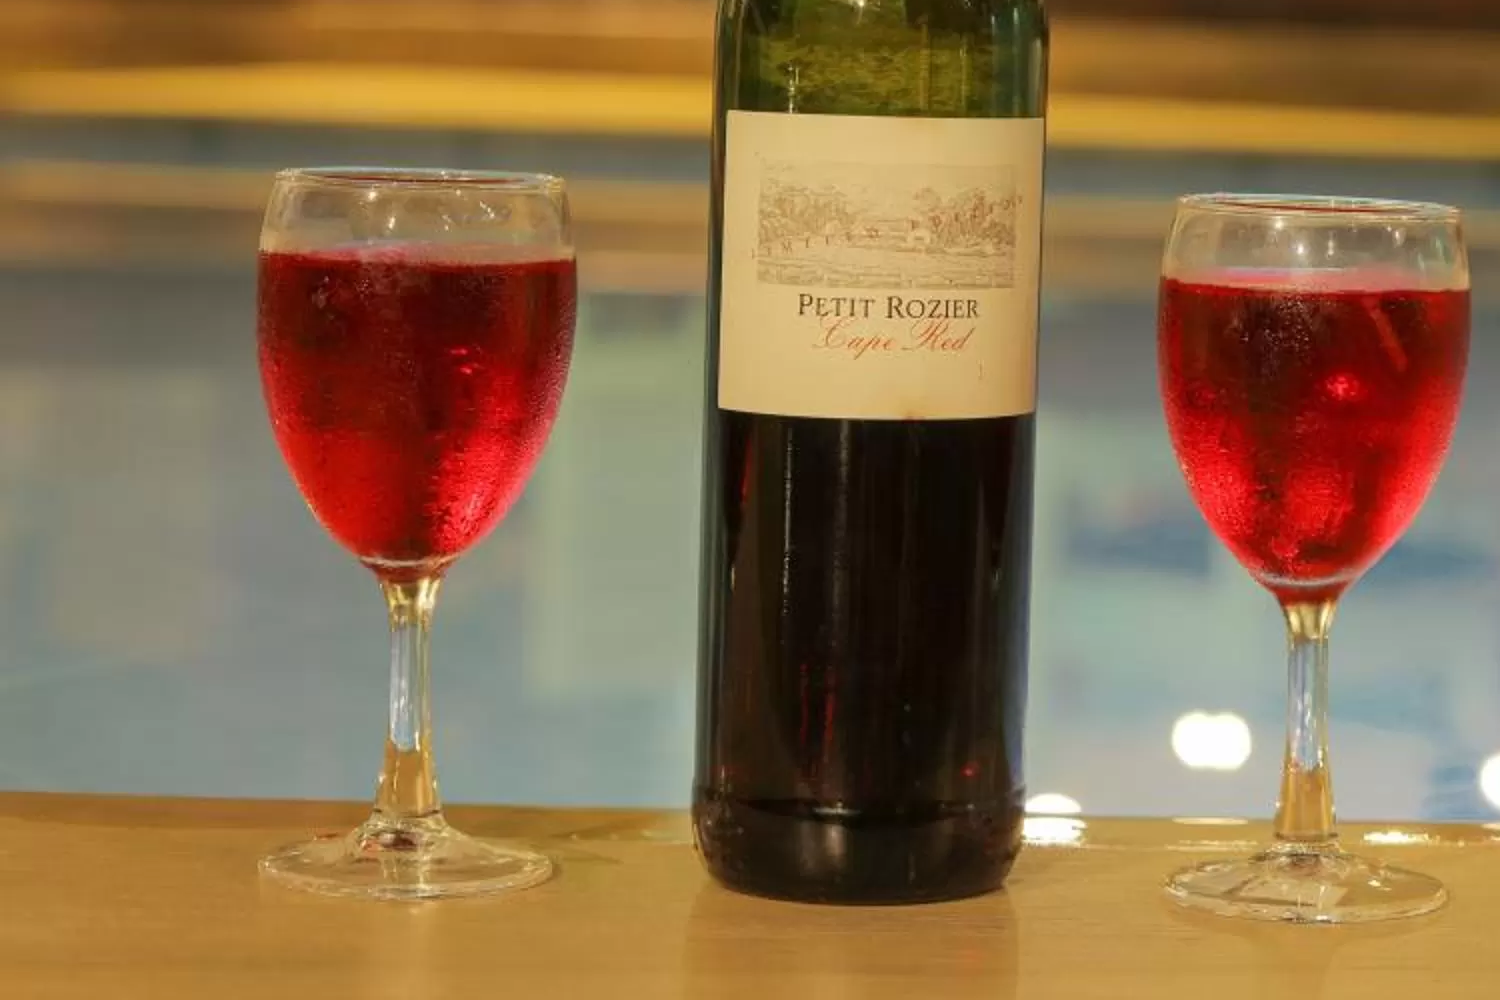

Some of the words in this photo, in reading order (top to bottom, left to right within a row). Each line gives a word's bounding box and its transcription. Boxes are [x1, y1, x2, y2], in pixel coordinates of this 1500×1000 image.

[798, 293, 876, 318] PETIT
[885, 295, 980, 319] ROZIER
[812, 316, 896, 361] Cape
[901, 316, 976, 351] Red
